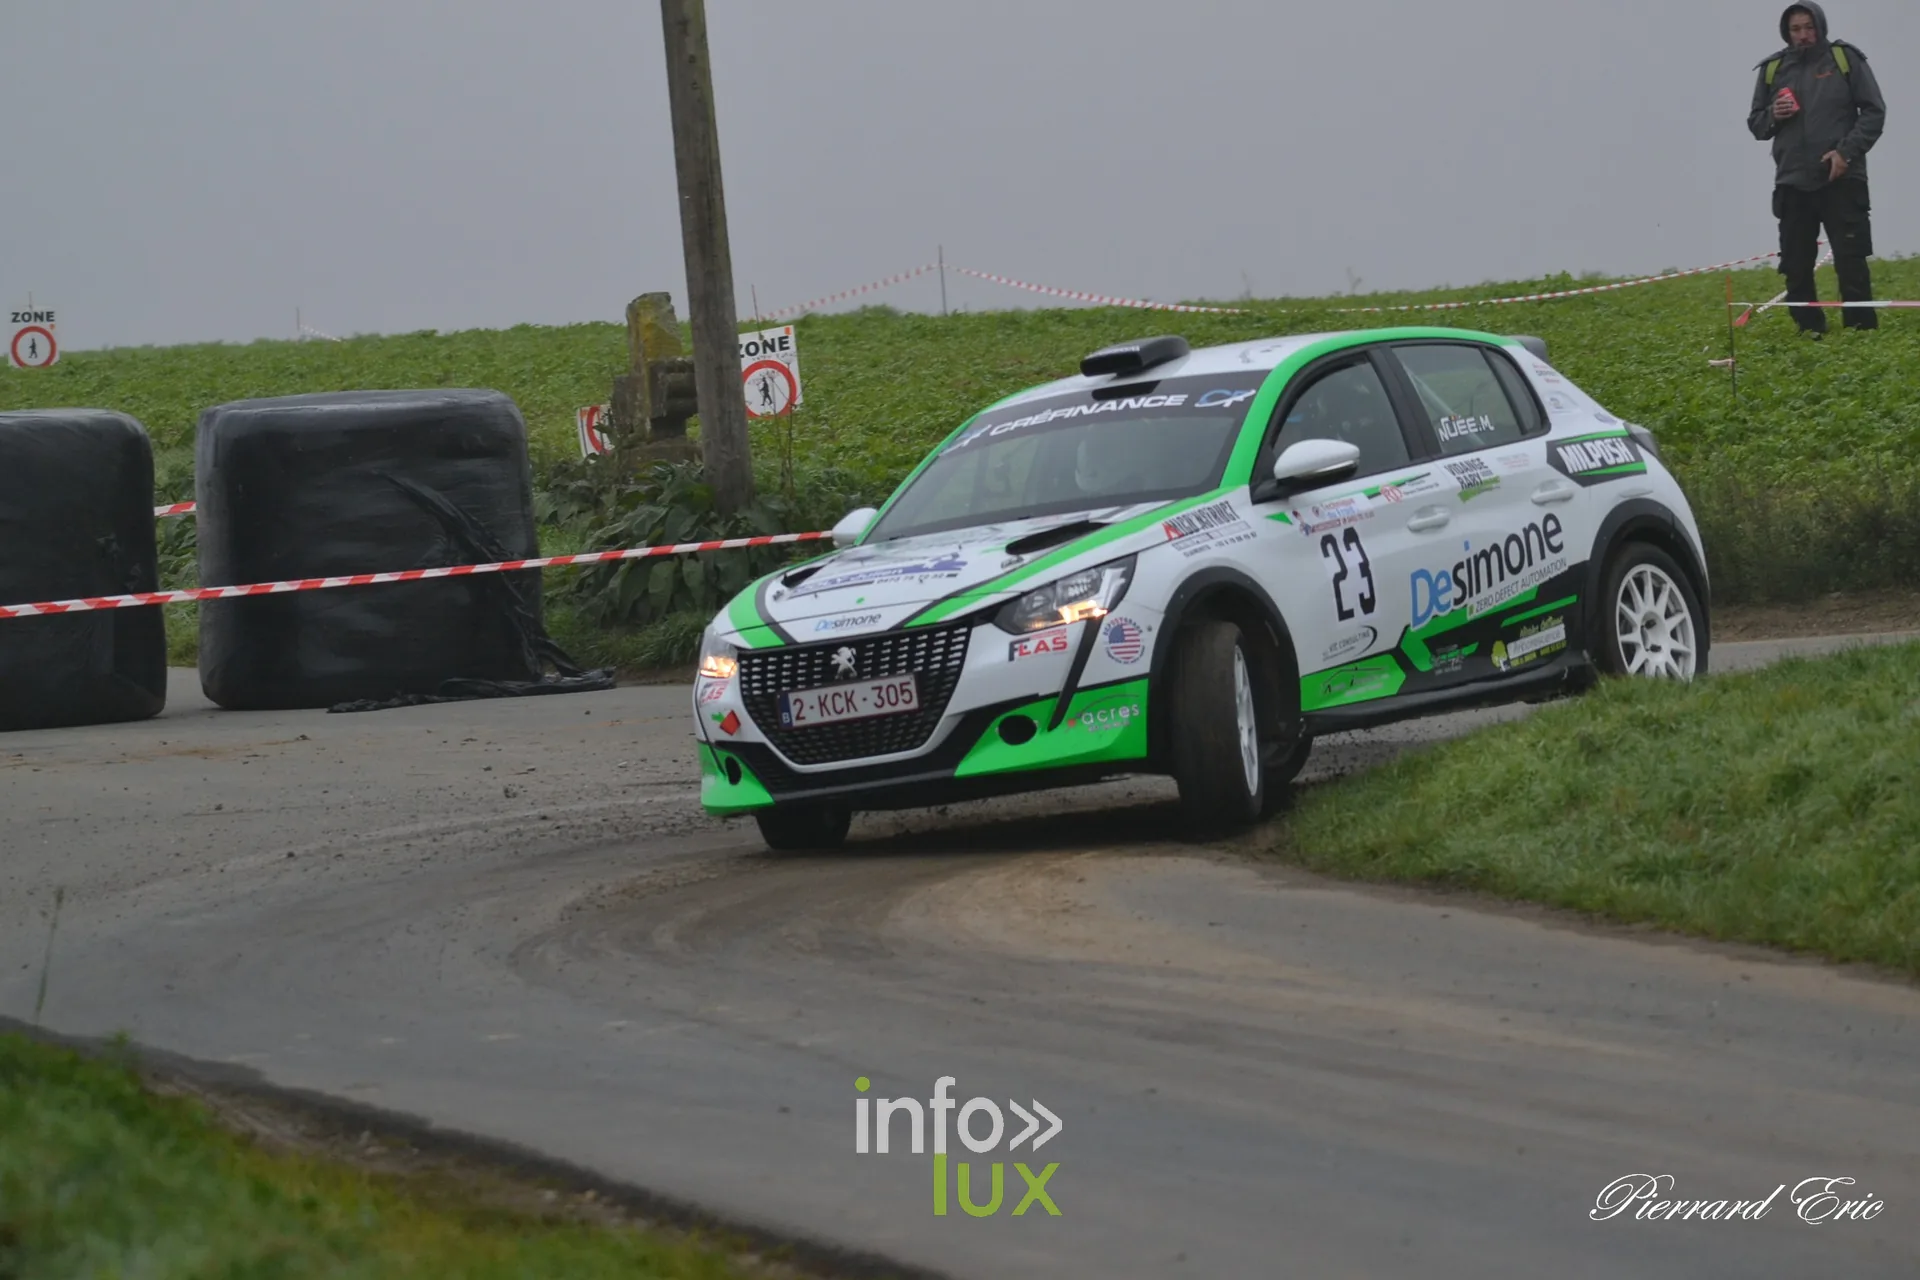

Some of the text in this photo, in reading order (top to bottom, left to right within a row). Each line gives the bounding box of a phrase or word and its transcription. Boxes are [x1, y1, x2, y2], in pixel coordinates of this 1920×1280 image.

[11, 311, 55, 323] ZONE
[1556, 437, 1635, 474] MILPOSH
[1321, 527, 1376, 622] 23
[1411, 513, 1564, 629] Desimone
[1475, 557, 1567, 614] ZERO DEFECT AUTOMATION
[815, 612, 882, 633] Desimone
[1081, 704, 1140, 725] acres
